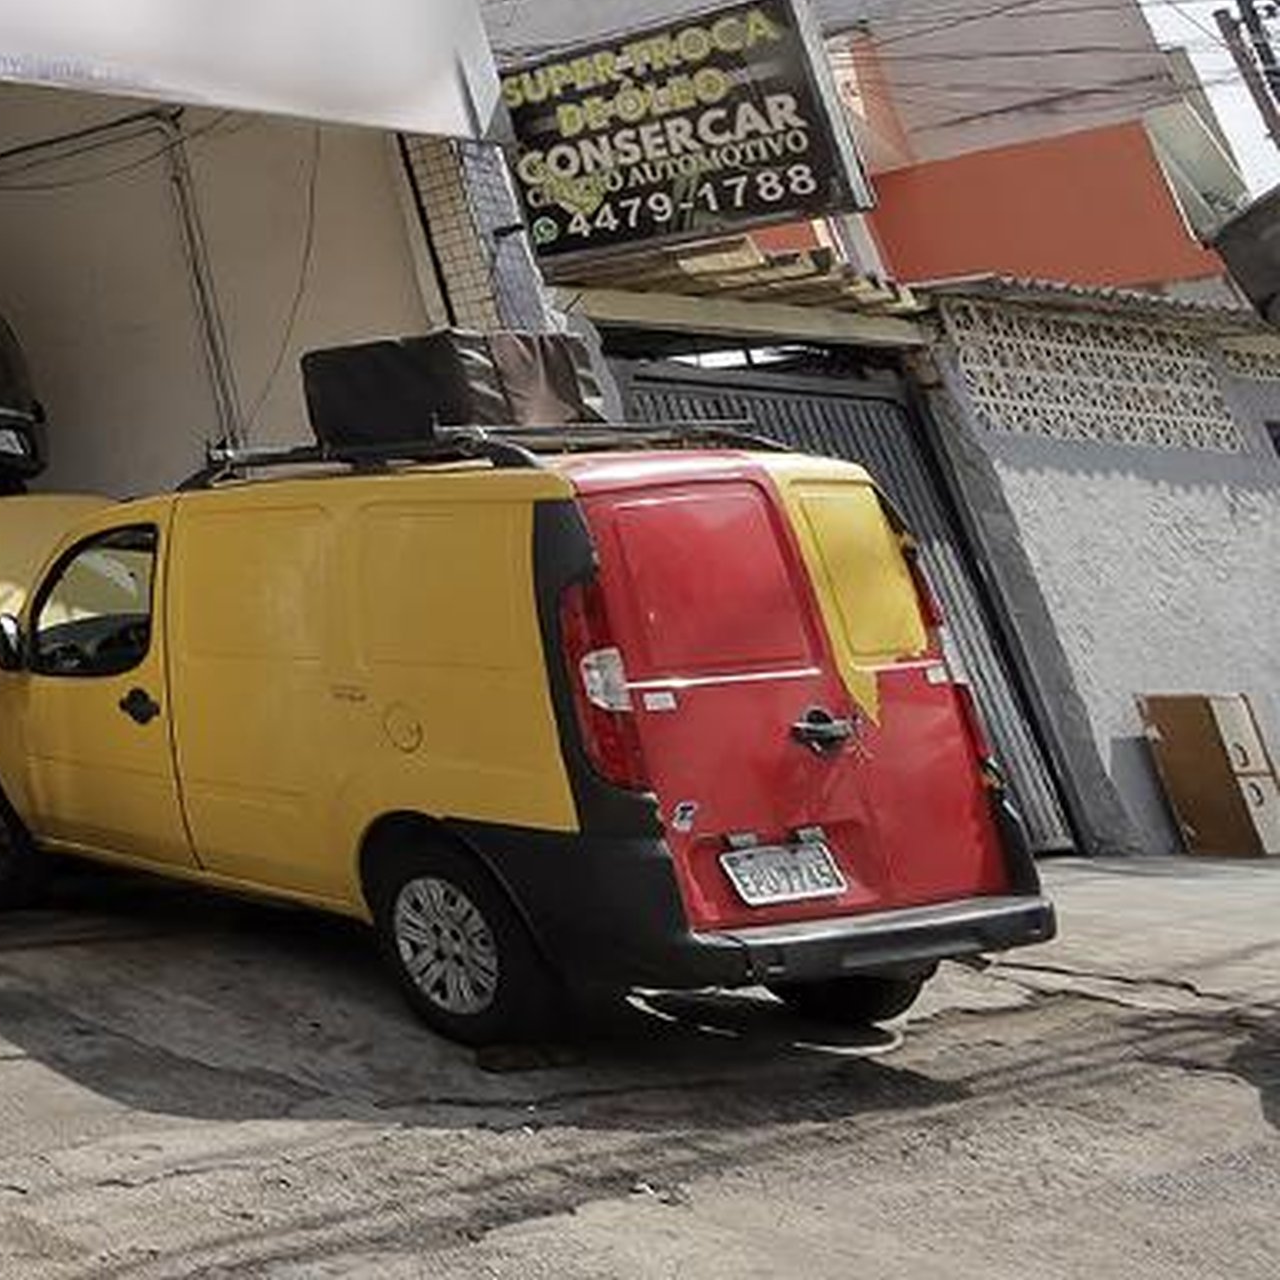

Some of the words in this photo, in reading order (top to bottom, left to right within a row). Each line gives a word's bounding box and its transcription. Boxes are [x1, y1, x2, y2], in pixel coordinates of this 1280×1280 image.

[619, 10, 780, 69] TROCA
[518, 93, 807, 186] CONSERCAR
[627, 129, 808, 189] AUTOMOTIVO
[568, 164, 817, 237] 4479-1788
